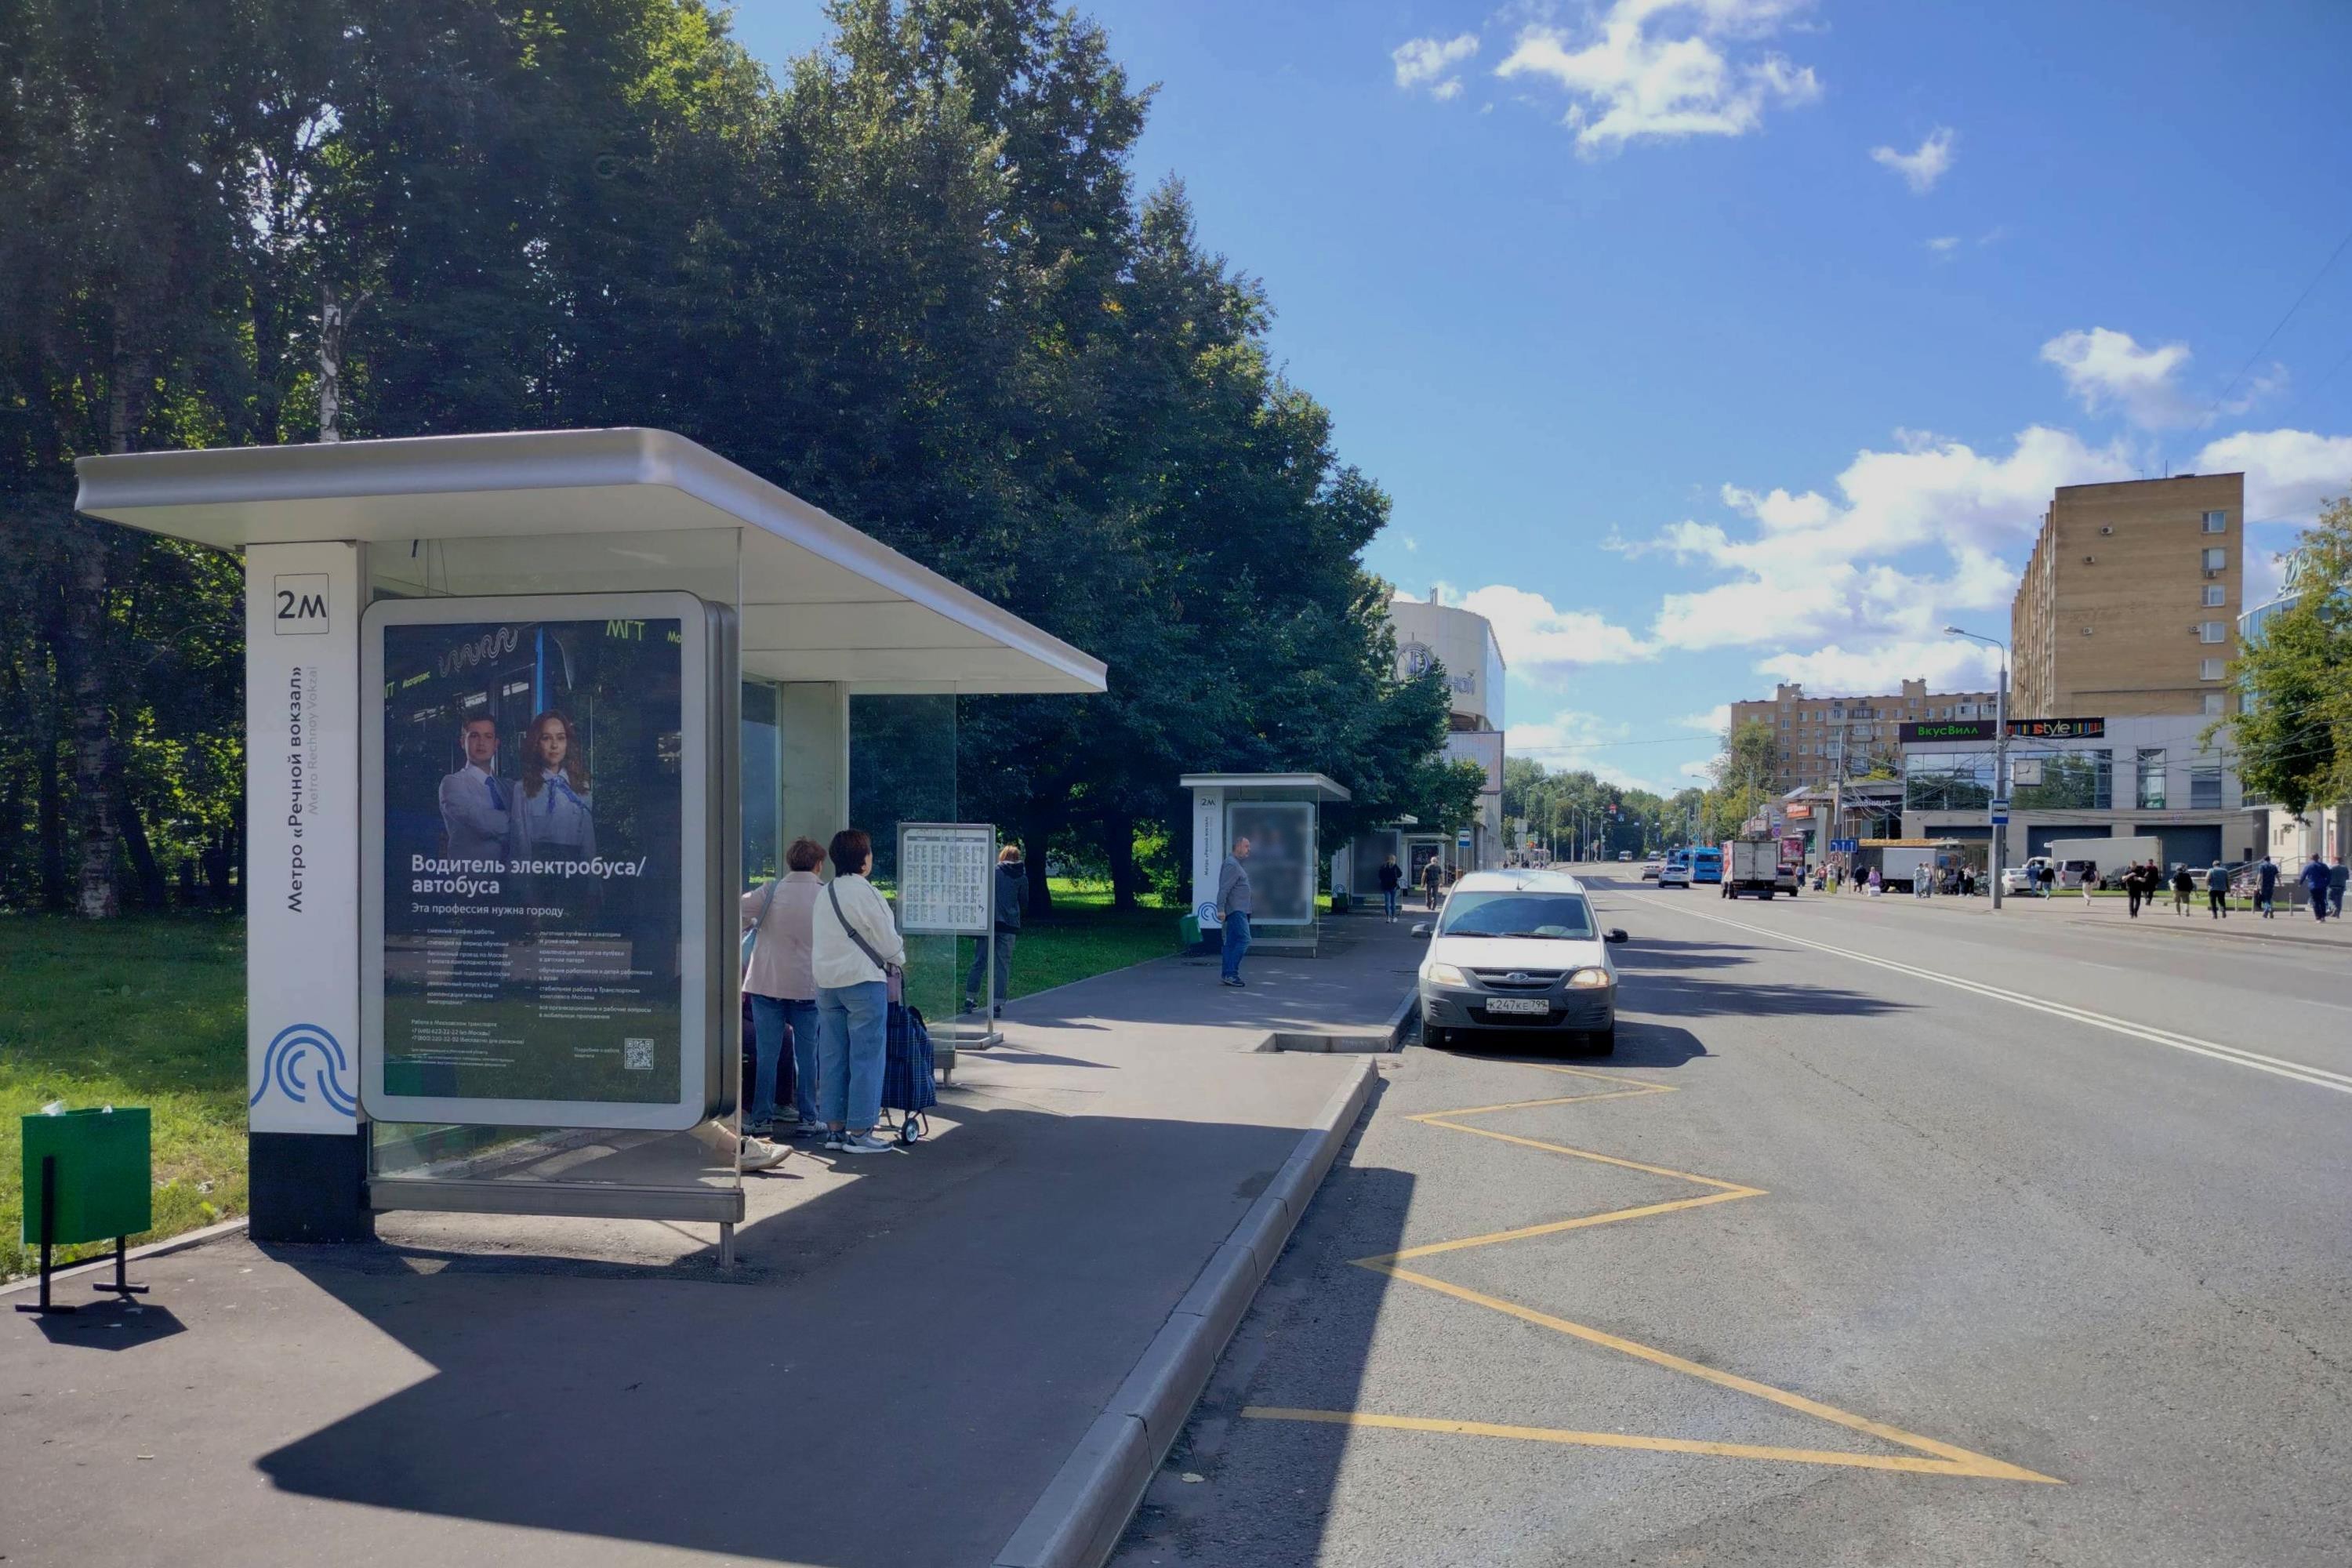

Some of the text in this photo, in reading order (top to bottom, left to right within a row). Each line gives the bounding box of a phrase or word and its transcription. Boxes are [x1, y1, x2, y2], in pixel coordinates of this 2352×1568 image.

[606, 619, 646, 641] МГТ
[307, 666, 319, 815] Metro Rechnoy Vokzal
[1917, 725, 1979, 737] ВкусВилл
[287, 666, 306, 913] Метро «Речной вокзал»
[412, 854, 647, 880] Водитель электробуса/
[412, 876, 500, 898] автобуса
[412, 902, 564, 917] Эта профессия нужна городу
